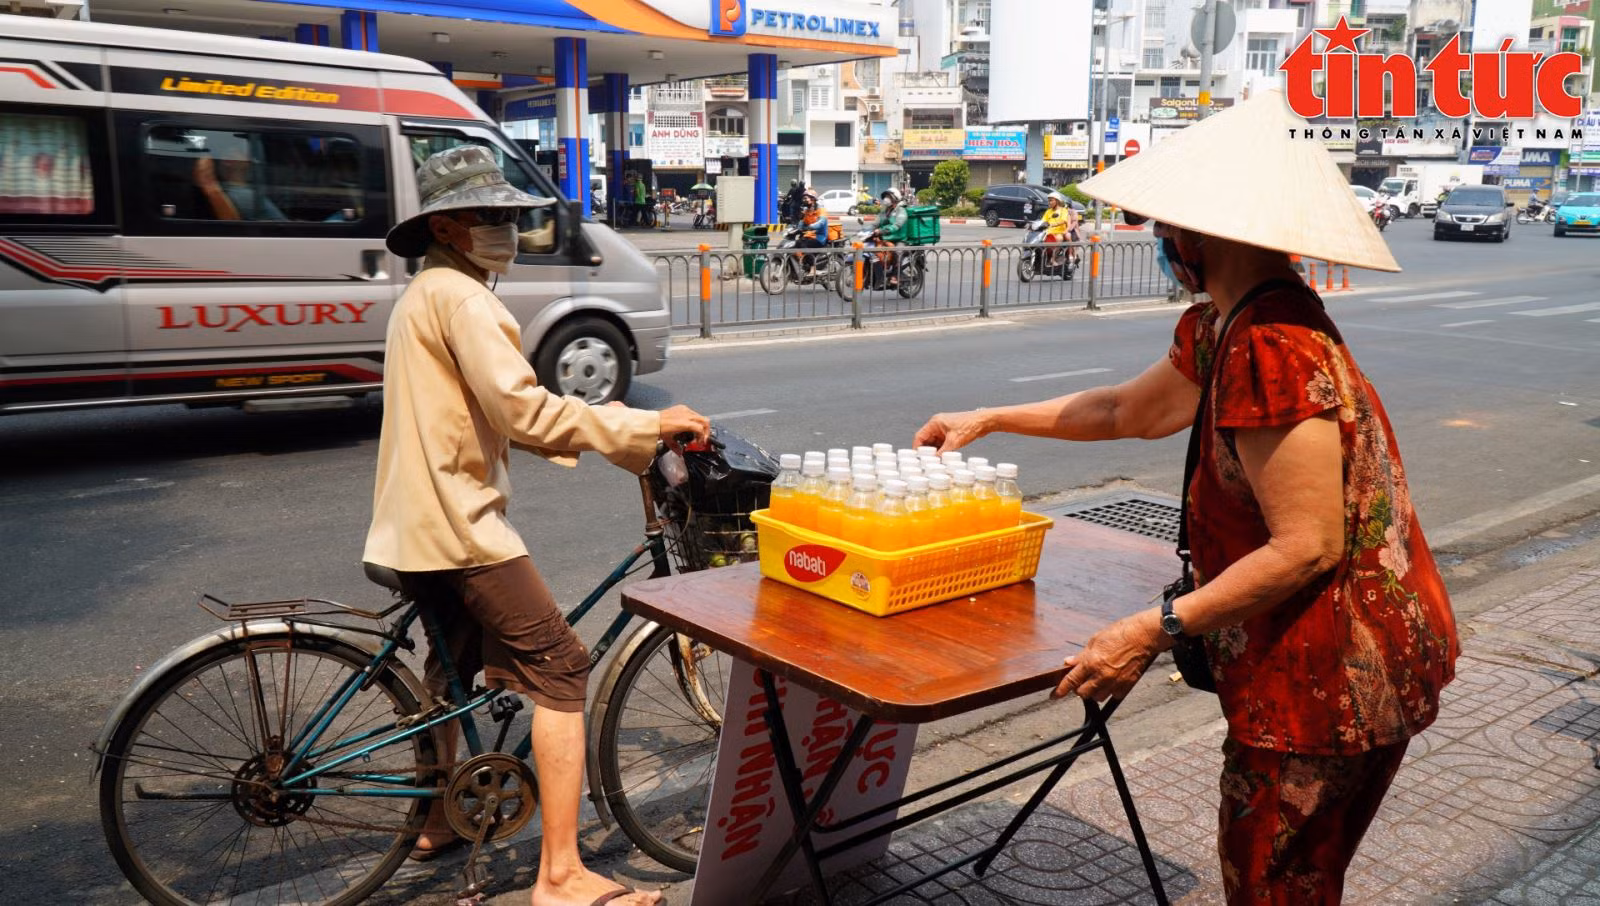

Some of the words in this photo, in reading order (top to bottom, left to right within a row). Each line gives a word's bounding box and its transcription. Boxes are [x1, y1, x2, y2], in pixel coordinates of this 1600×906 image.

[751, 9, 880, 37] PETROLIMEX
[160, 77, 255, 97] Limited
[255, 85, 340, 104] Edition
[1161, 98, 1215, 107] SaigonLio
[652, 130, 670, 138] ANH
[1521, 151, 1550, 163] UMA
[1504, 178, 1531, 188] PUMA
[156, 302, 376, 332] LUXURY
[215, 376, 263, 387] NEW
[268, 373, 327, 385] SPORT
[790, 550, 826, 577] nabati
[801, 694, 853, 782] HẬN
[853, 719, 898, 794] ỰC
[717, 742, 776, 861] NHẬN
